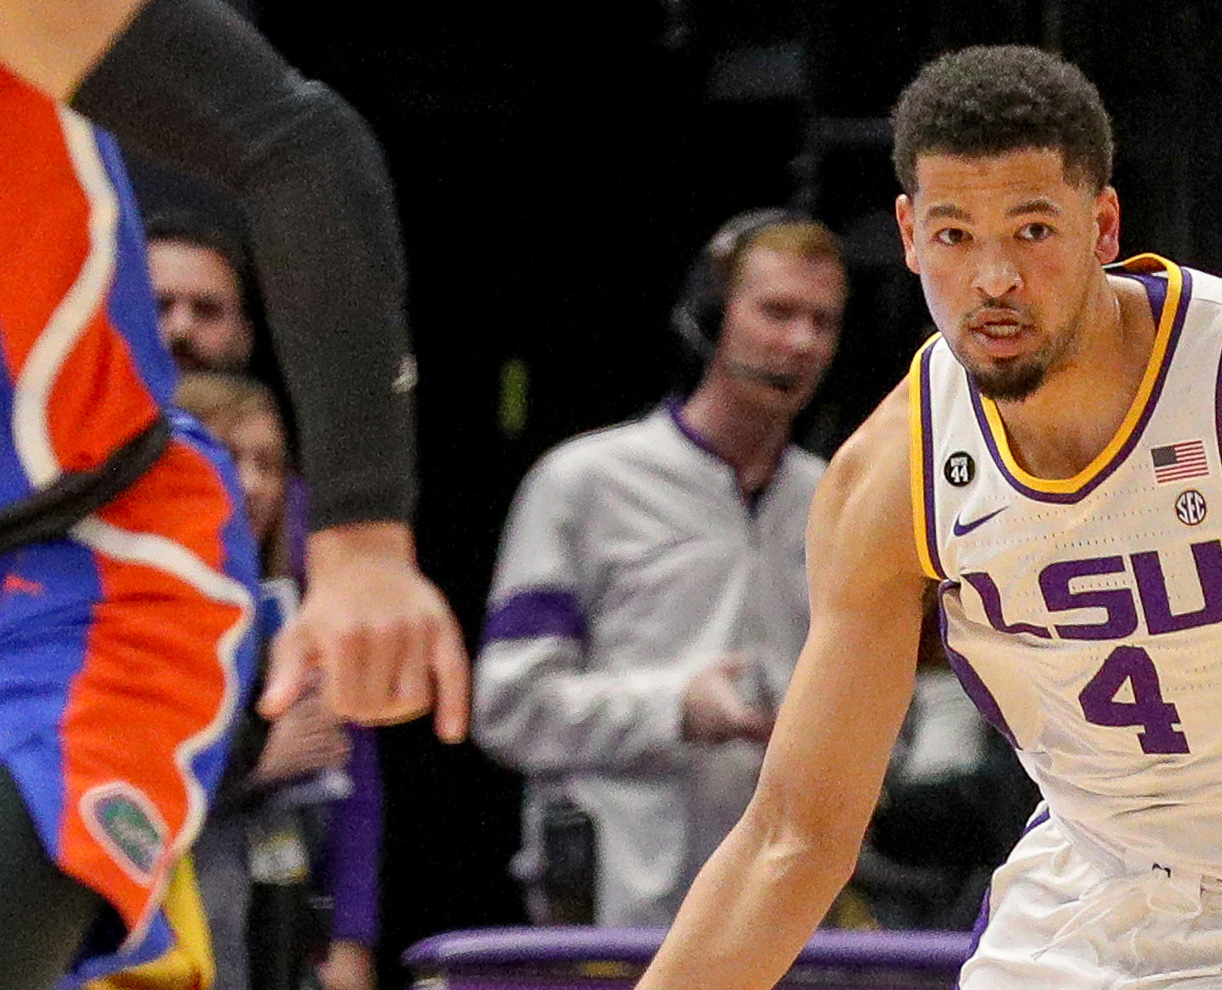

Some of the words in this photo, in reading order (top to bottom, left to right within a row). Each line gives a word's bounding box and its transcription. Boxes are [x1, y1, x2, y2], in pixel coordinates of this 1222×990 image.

[951, 465, 969, 483] 44
[1176, 492, 1205, 524] SEC
[1078, 645, 1191, 755] 4
